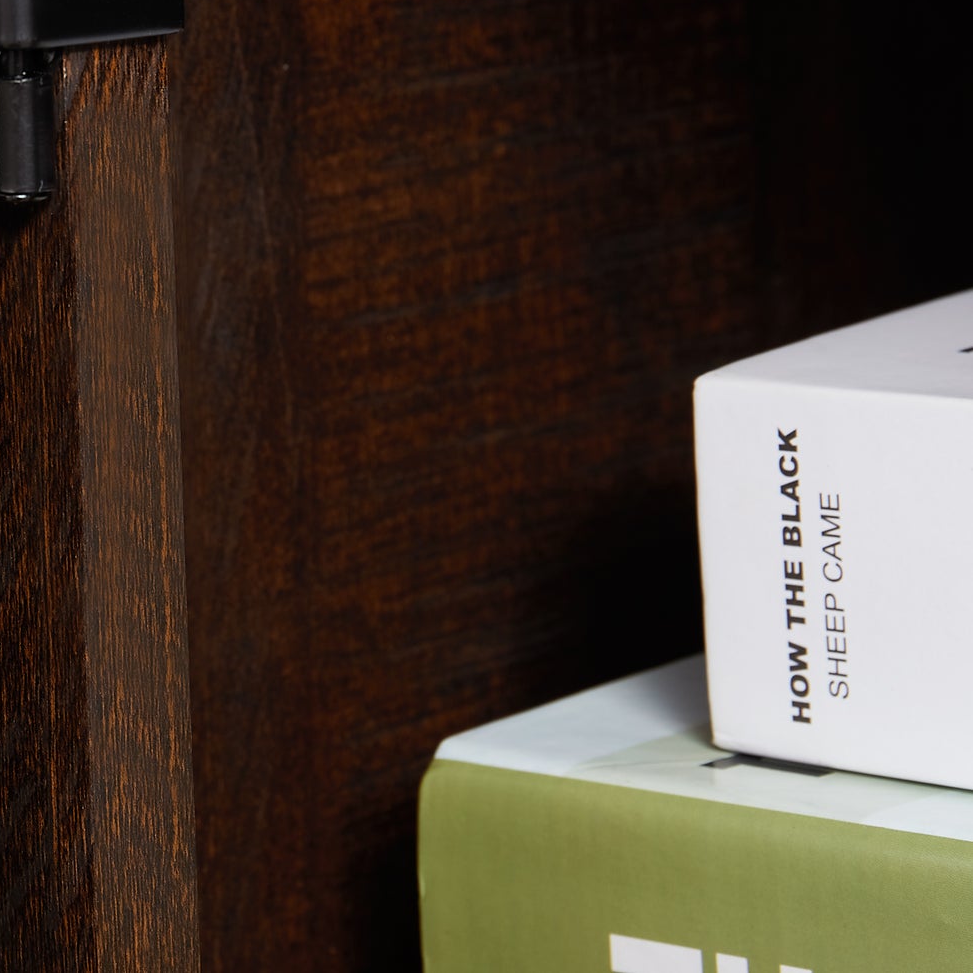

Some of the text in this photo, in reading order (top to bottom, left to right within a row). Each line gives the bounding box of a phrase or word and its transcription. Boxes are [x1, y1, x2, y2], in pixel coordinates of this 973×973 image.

[777, 427, 812, 724] HOW THE BLACK
[819, 492, 849, 699] SHEEP CAME
